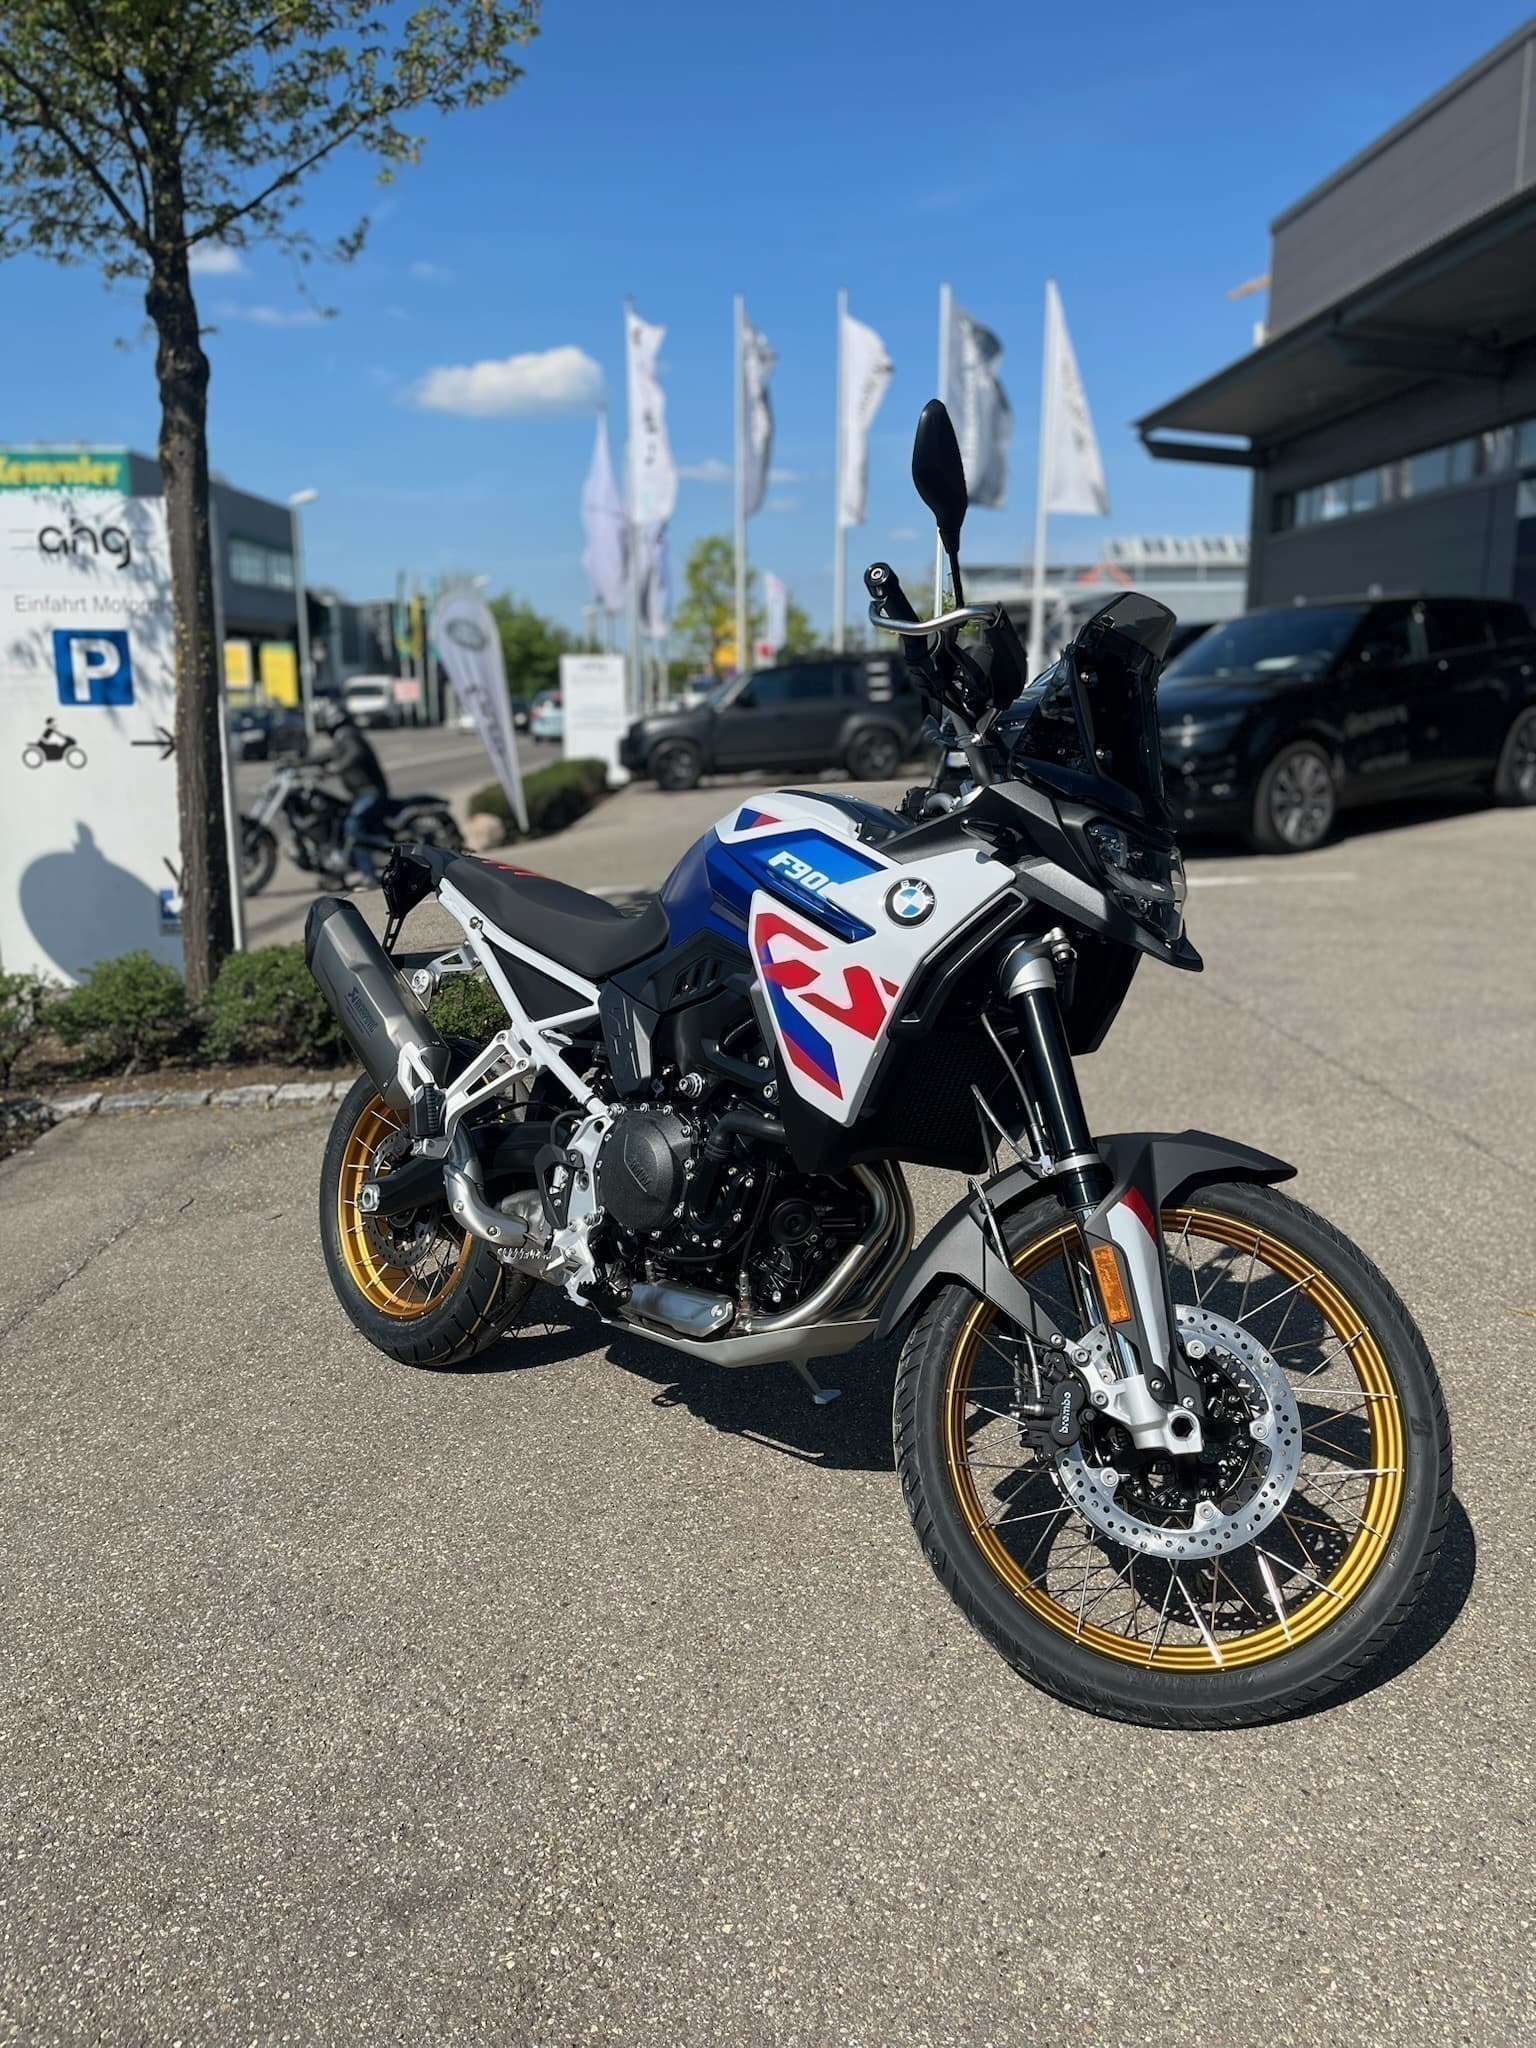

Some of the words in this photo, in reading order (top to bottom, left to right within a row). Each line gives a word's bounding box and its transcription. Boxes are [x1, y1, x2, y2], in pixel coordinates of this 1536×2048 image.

[13, 594, 86, 613] Einfahrt
[69, 637, 122, 702] P
[900, 879, 935, 905] BMW
[1058, 1391, 1072, 1434] brembo
